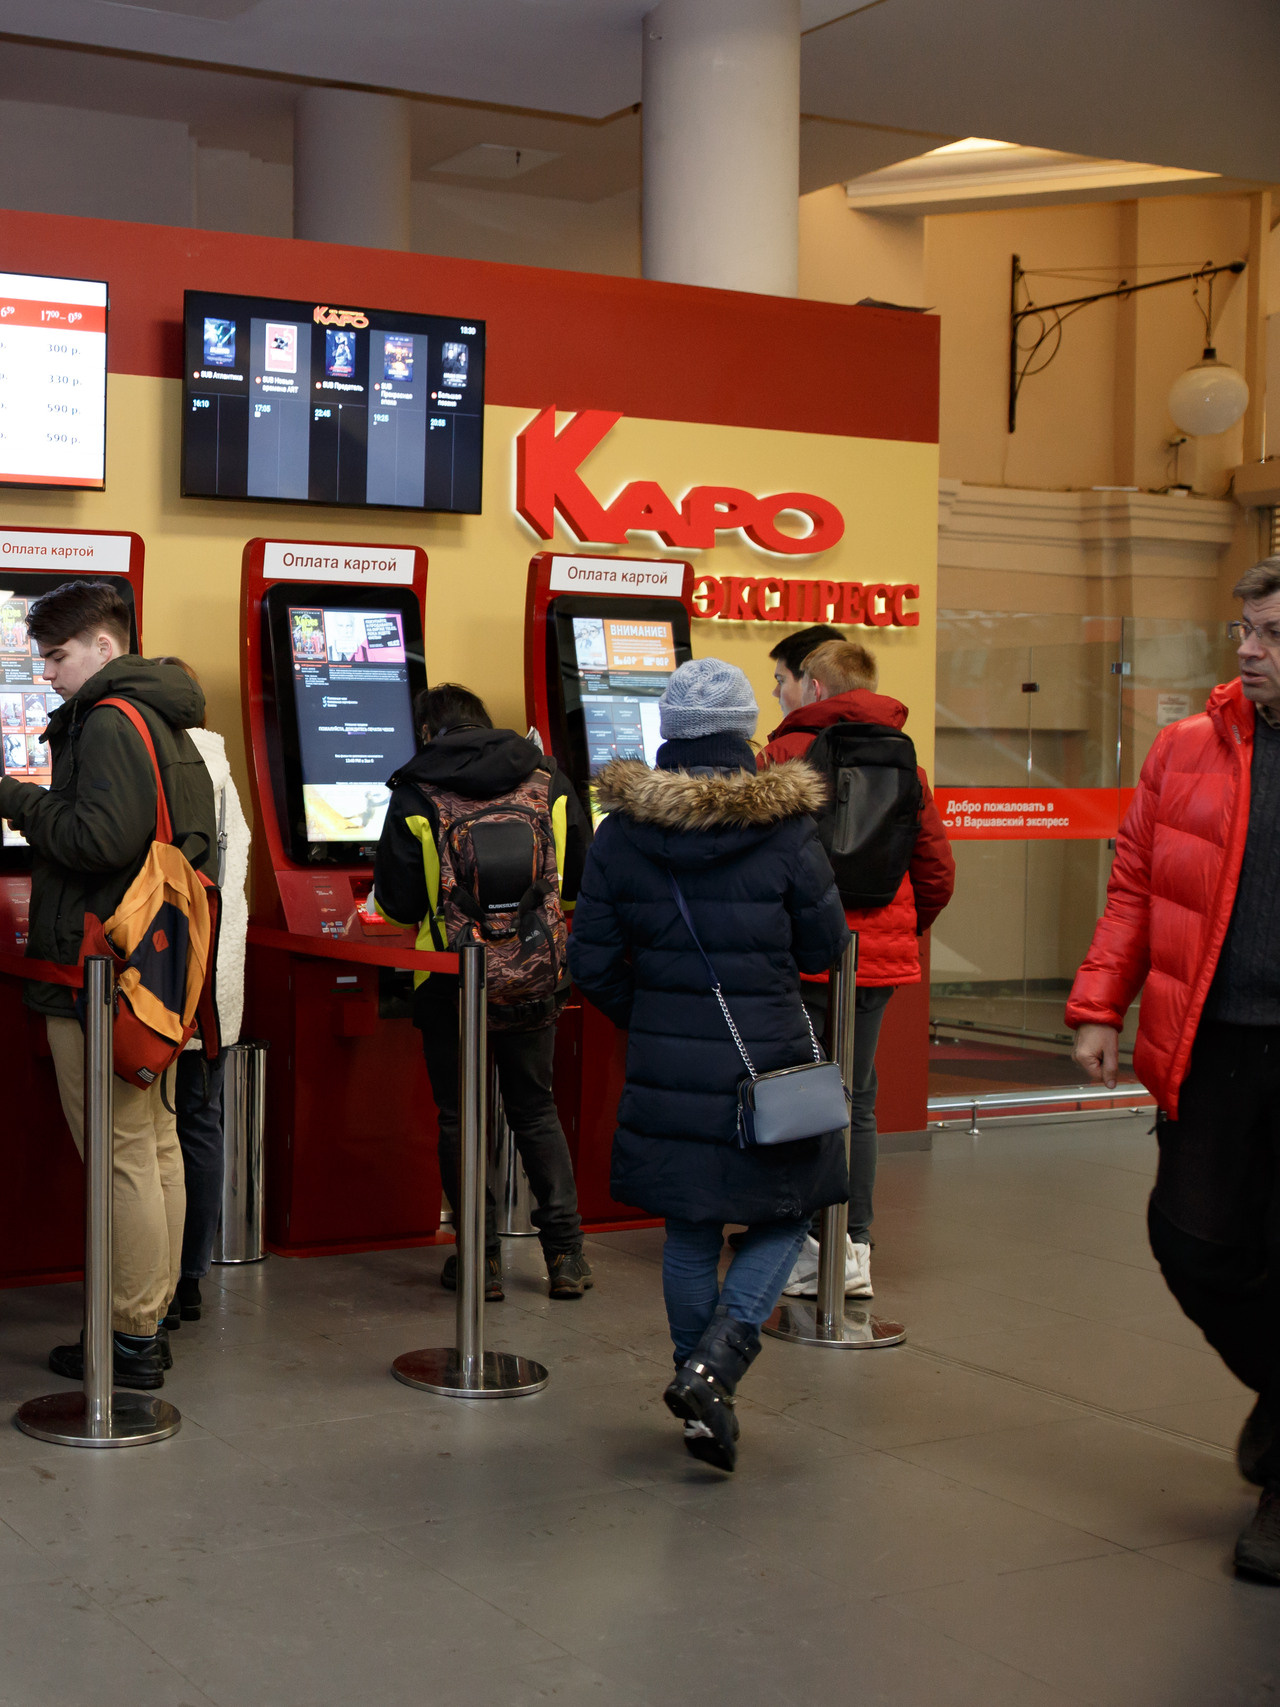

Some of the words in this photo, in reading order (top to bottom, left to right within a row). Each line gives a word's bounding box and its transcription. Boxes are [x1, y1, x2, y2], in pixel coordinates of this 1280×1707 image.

[313, 305, 369, 329] КАРО
[48, 344, 68, 353] 300
[49, 375, 69, 384] 330
[47, 403, 68, 413] 590
[47, 433, 68, 443] 590
[516, 404, 845, 555] КАРО
[2, 543, 47, 557] Оплата
[51, 545, 94, 560] картой
[283, 552, 339, 569] Оплата
[344, 558, 397, 574] картой
[567, 566, 617, 582] Оплата
[621, 571, 668, 585] картой
[693, 575, 920, 627] ЭКСПРЕСС
[610, 624, 667, 638] ВНИМАНИЕ!
[946, 800, 981, 815] Добро
[984, 801, 1045, 813] пожаловать
[1047, 803, 1054, 811] в
[955, 816, 962, 826] 9
[964, 816, 1024, 829] Варшавский
[1026, 817, 1069, 829] экспресс
